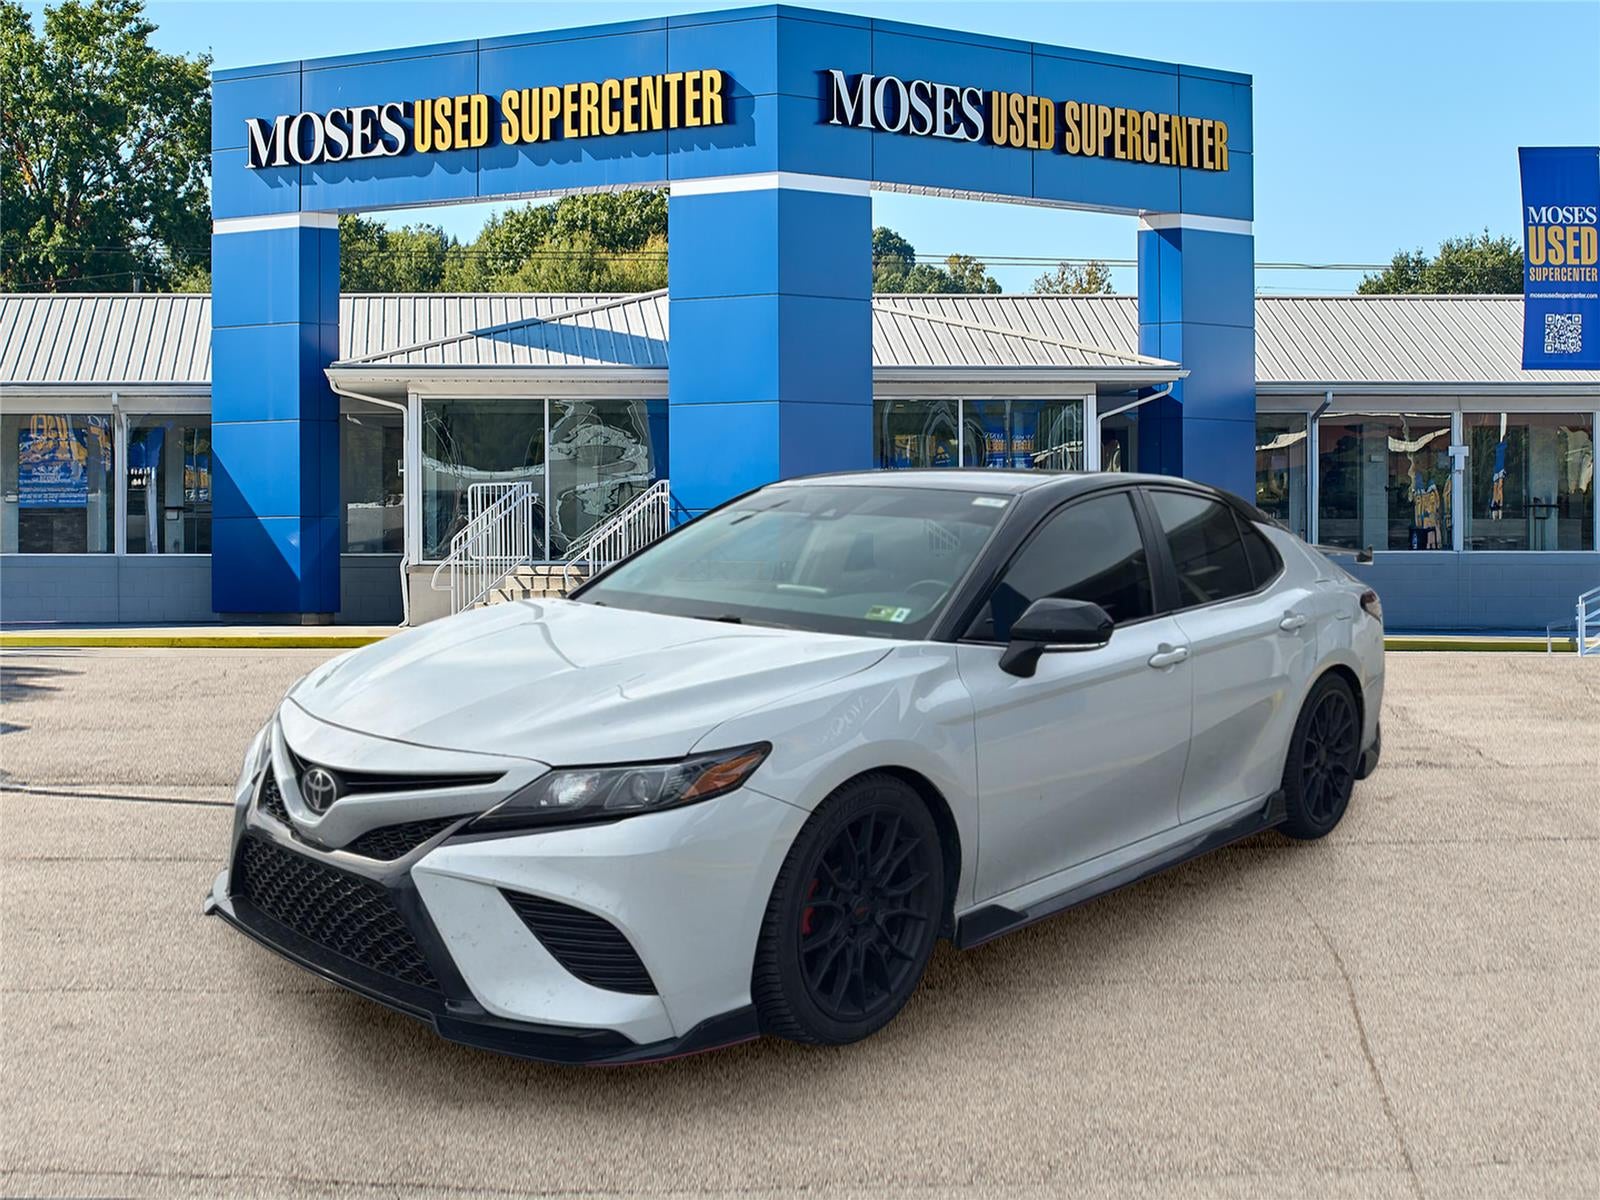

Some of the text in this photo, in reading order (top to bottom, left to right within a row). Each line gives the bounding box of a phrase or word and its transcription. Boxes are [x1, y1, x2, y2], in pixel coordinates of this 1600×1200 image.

[244, 69, 725, 169] MOSES USED SUPERCENTER
[828, 69, 1229, 171] MOSES USED SUPERCENTER
[1527, 206, 1597, 224] MOSES
[1528, 226, 1598, 265] USED
[1529, 267, 1598, 282] SUPERCENTER
